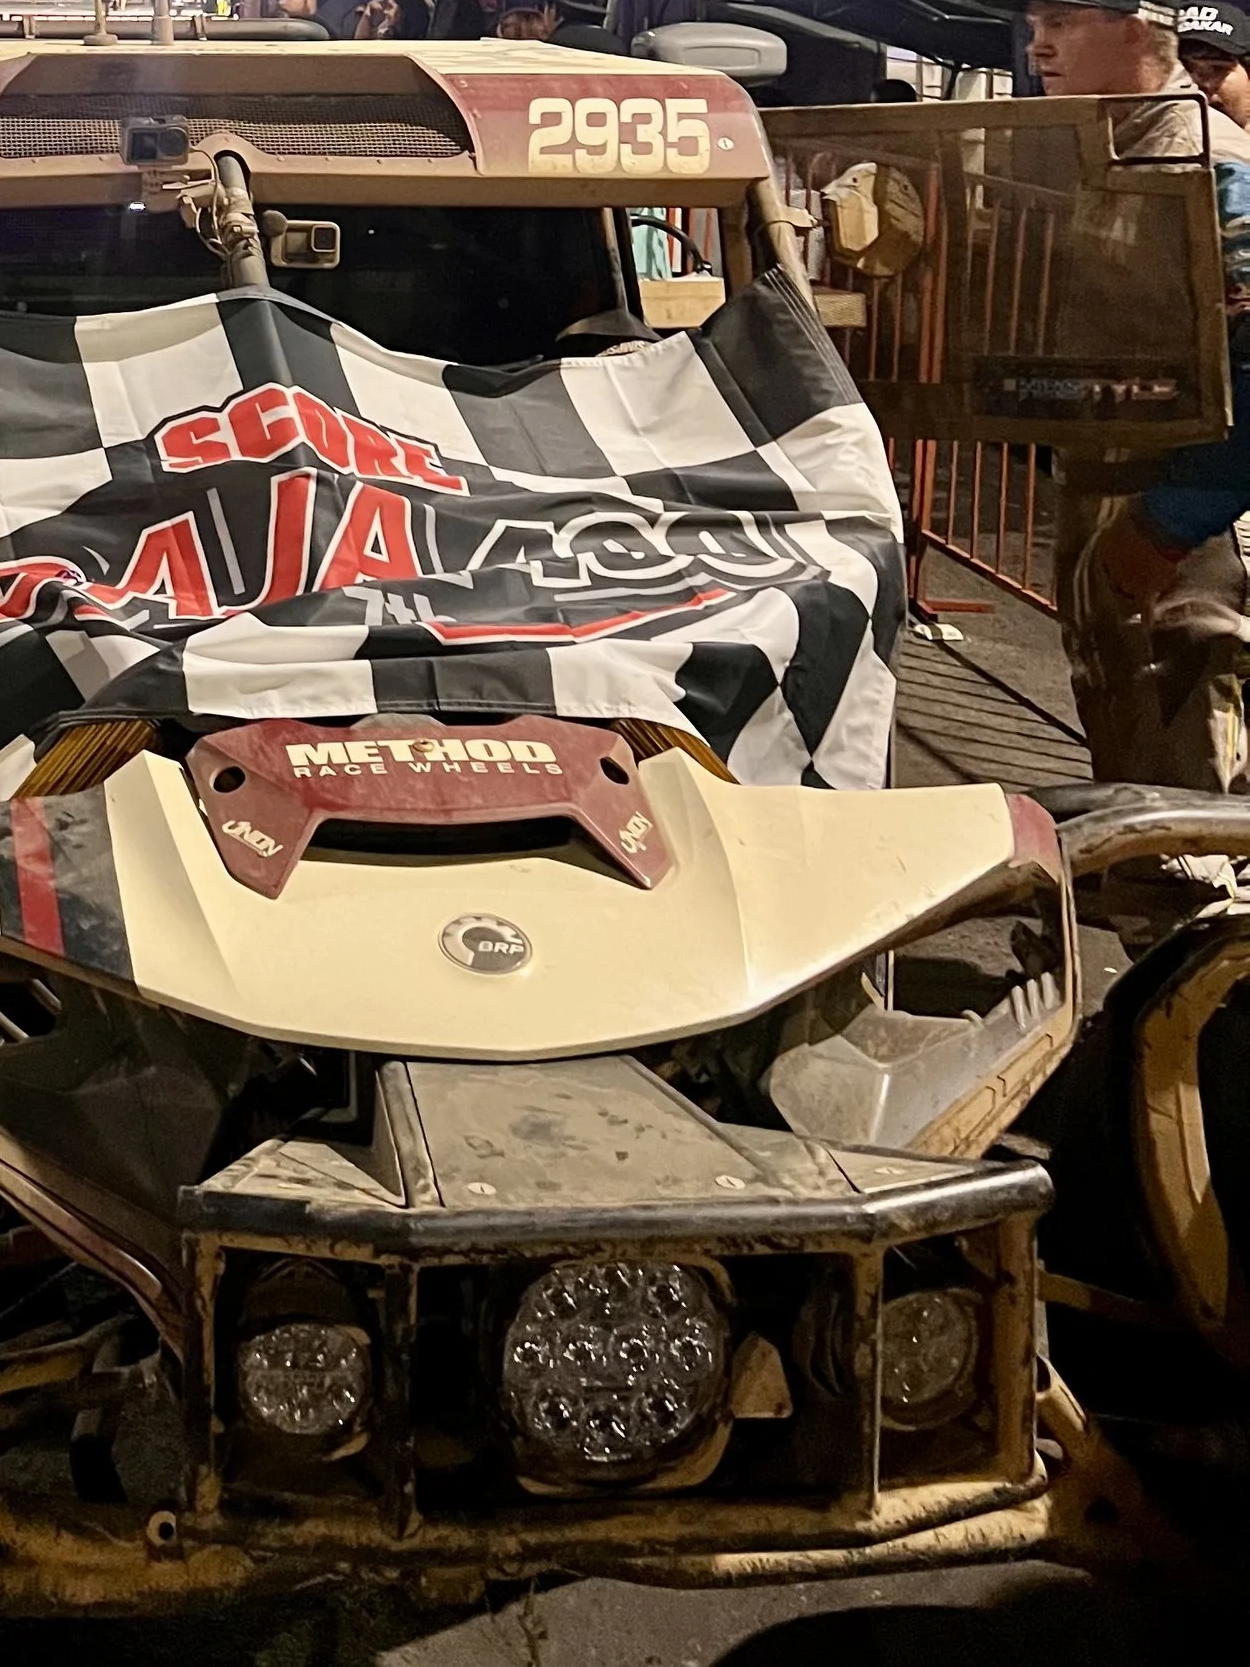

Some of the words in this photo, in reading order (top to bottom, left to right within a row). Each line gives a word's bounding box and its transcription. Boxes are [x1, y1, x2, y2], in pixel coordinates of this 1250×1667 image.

[528, 98, 711, 175] 2935
[153, 383, 472, 497] SCORE
[285, 738, 557, 767] METHOD
[293, 764, 388, 779] RACE
[408, 761, 563, 775] WHEELS
[477, 940, 525, 955] BRP
